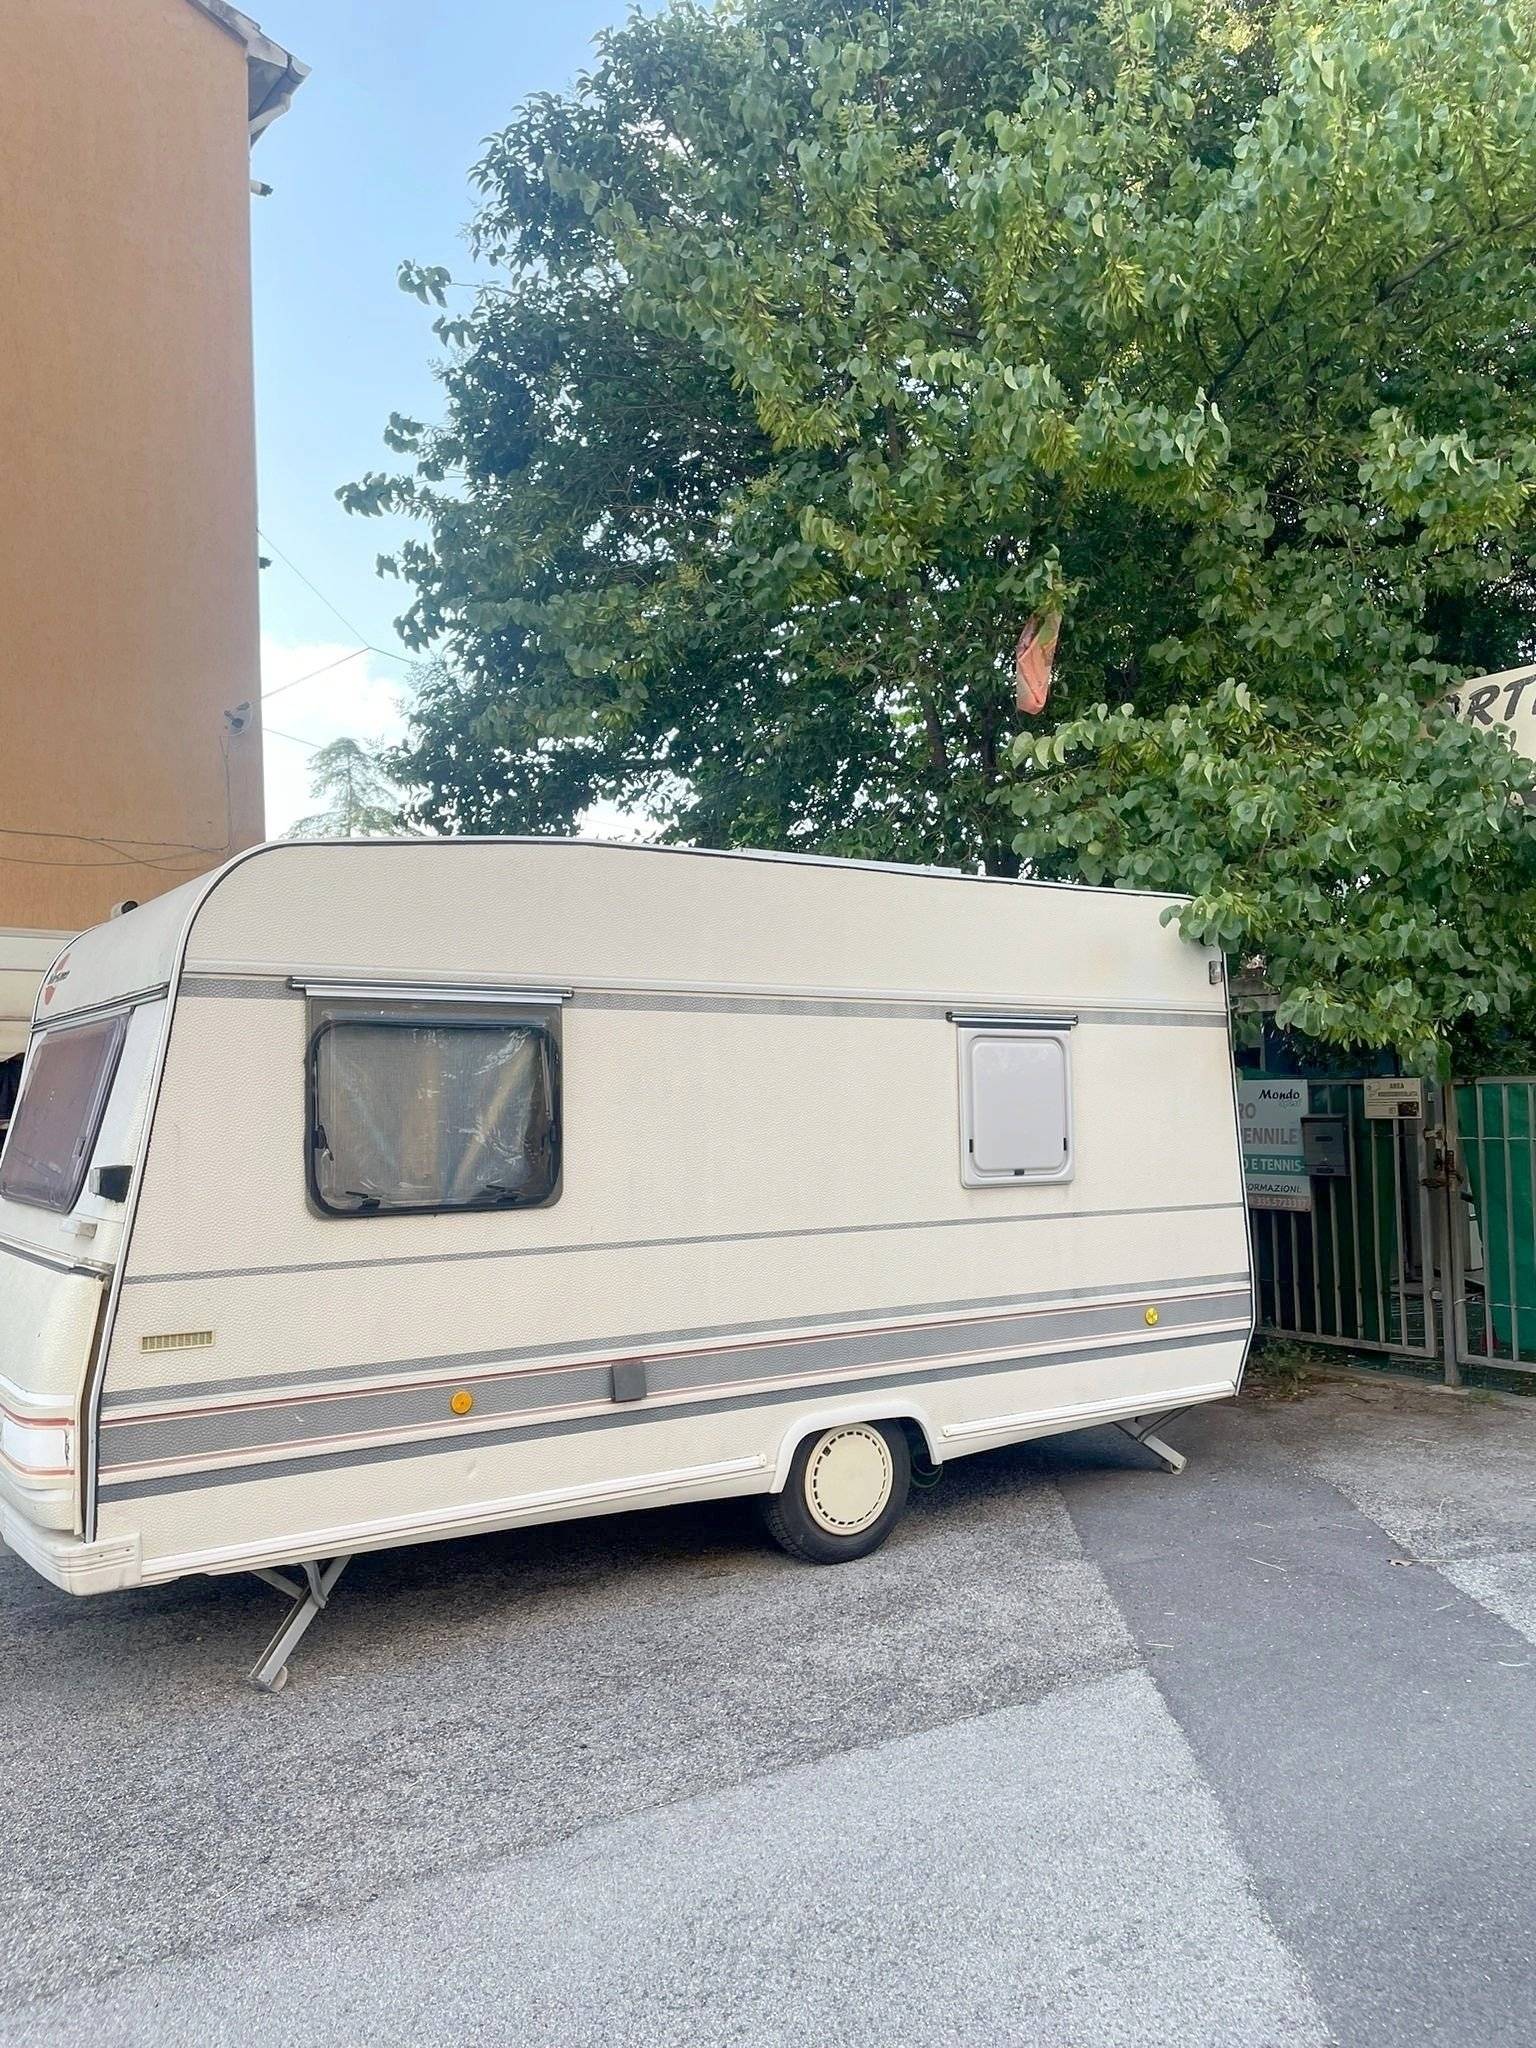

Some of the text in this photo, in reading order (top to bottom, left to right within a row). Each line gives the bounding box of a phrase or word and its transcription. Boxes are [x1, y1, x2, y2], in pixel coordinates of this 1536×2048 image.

[1258, 1089, 1300, 1100] Mondo
[1240, 1127, 1298, 1145] ENNILE
[1251, 1158, 1259, 1170] E
